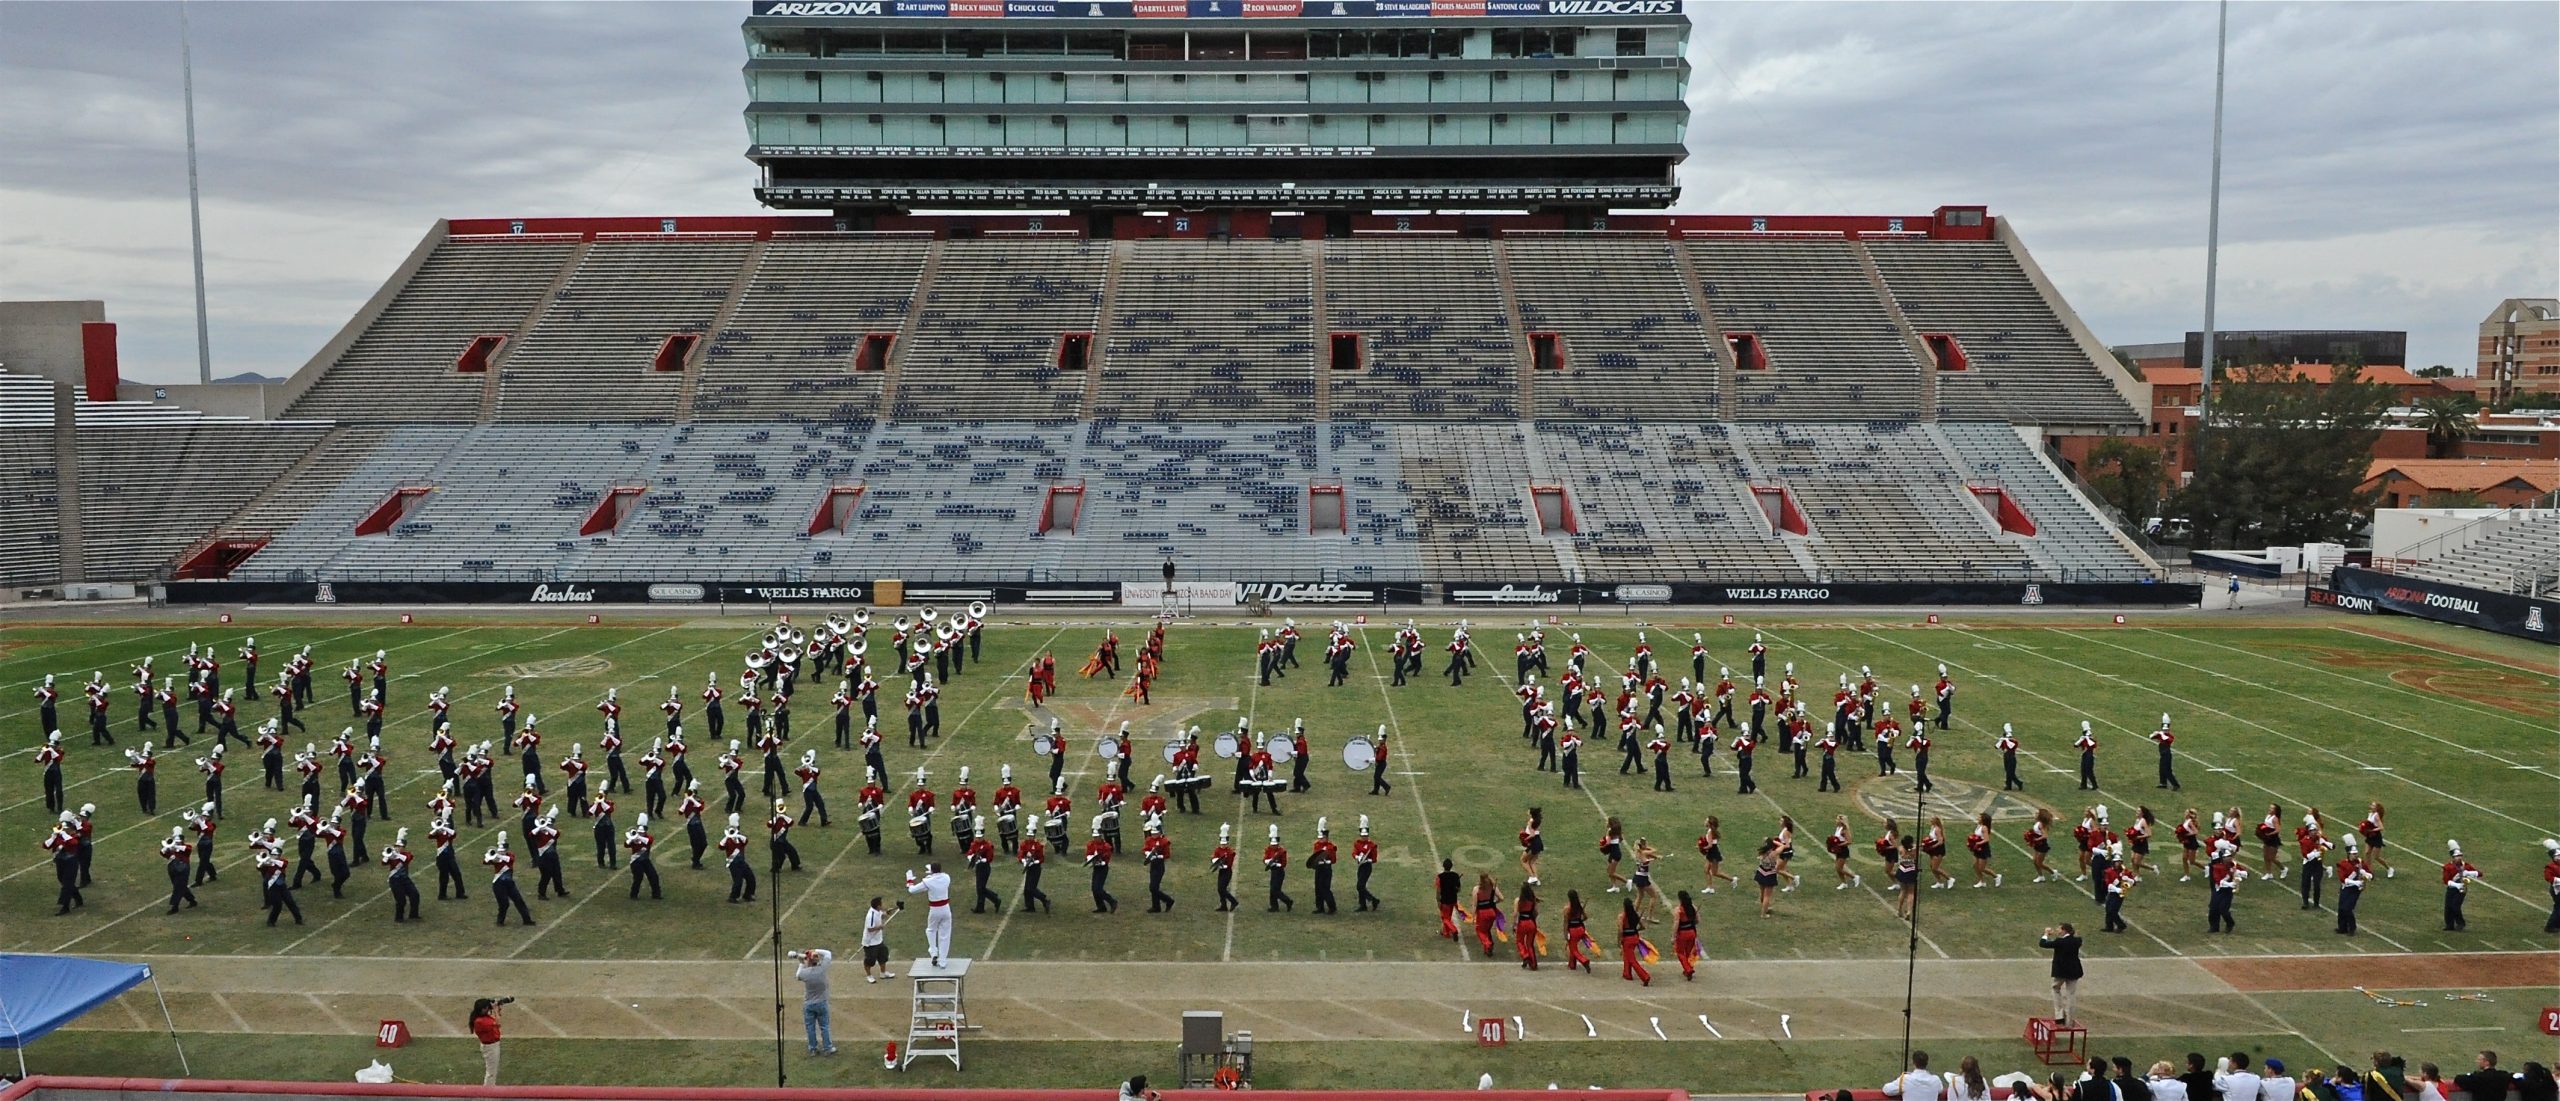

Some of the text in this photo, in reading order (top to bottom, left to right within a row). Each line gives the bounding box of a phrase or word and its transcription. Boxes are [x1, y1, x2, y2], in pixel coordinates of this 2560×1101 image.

[766, 3, 881, 15] ARIZONA
[897, 3, 905, 11] 22
[1549, 1, 1676, 13] WILDCATS
[664, 224, 674, 232] 18
[1029, 223, 1041, 231] 20
[1177, 222, 1187, 230] 21
[1397, 222, 1409, 231] 22
[1593, 222, 1605, 231] 23
[1753, 223, 1765, 231] 24
[1890, 224, 1902, 232] 25
[156, 389, 166, 398] 16
[316, 583, 335, 602] A
[531, 584, 595, 602] Bashas'
[758, 588, 861, 598] WELLS FARGO
[1125, 589, 1158, 598] UNIVERSITY
[1200, 589, 1218, 598] BAND
[1220, 589, 1232, 598] DAY
[1636, 587, 1667, 595] CASINOS
[1726, 588, 1830, 599] WELLS FARGO
[2022, 584, 2043, 604] A
[2310, 591, 2373, 612] BEAR DOWN
[2384, 587, 2479, 614] ARIZONA FOOTBALL
[2525, 606, 2543, 631] A
[2549, 1012, 2560, 1031] 2
[379, 1024, 398, 1043] 40
[937, 1024, 951, 1040] 50
[1483, 1023, 1500, 1042] 40
